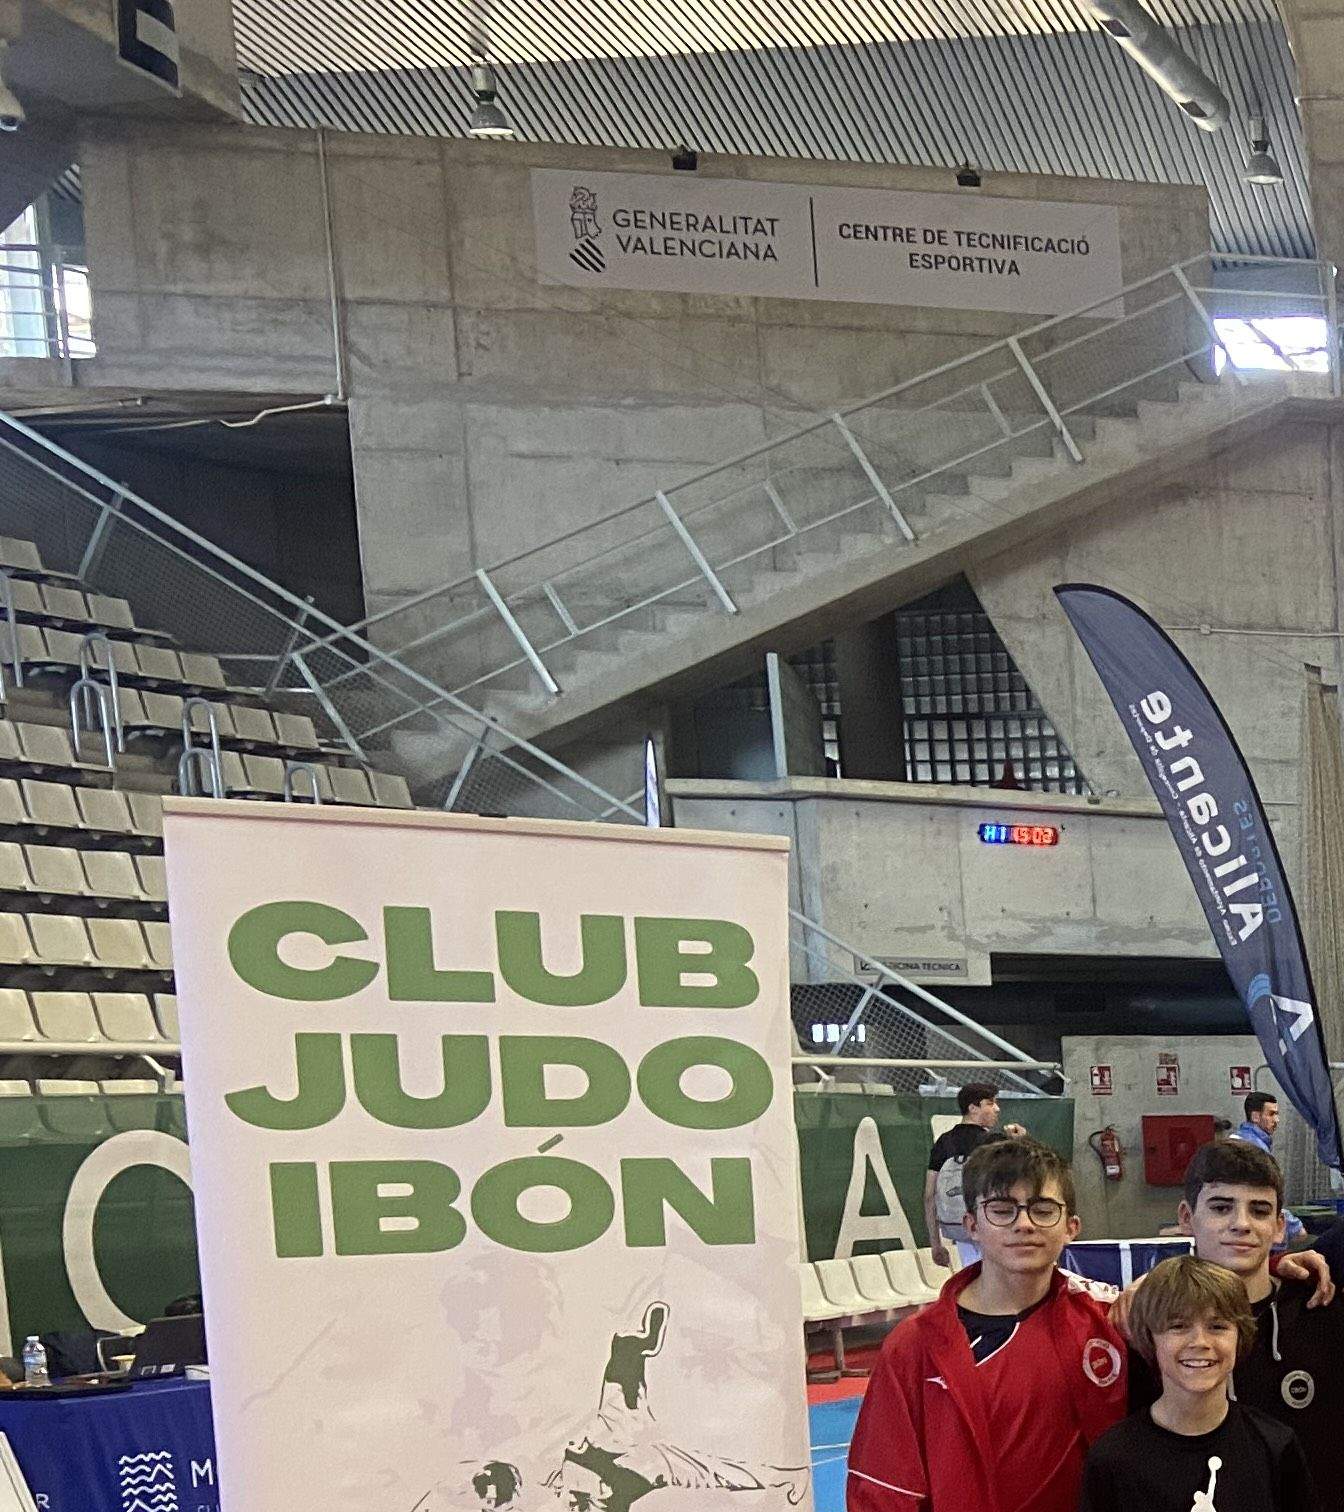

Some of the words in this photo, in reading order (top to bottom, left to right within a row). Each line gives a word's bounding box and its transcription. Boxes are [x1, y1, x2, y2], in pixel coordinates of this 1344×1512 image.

[612, 208, 780, 239] GENERALITAT
[838, 222, 919, 245] CENTRE
[923, 228, 950, 246] DE
[953, 230, 1090, 256] TECNIFICACIÓ
[616, 233, 779, 262] VALENCIANA
[908, 253, 1021, 277] ESPORTIVA
[227, 899, 760, 1009] CLUB
[224, 1031, 774, 1131] JUDO
[269, 1132, 756, 1259] IBÓN
